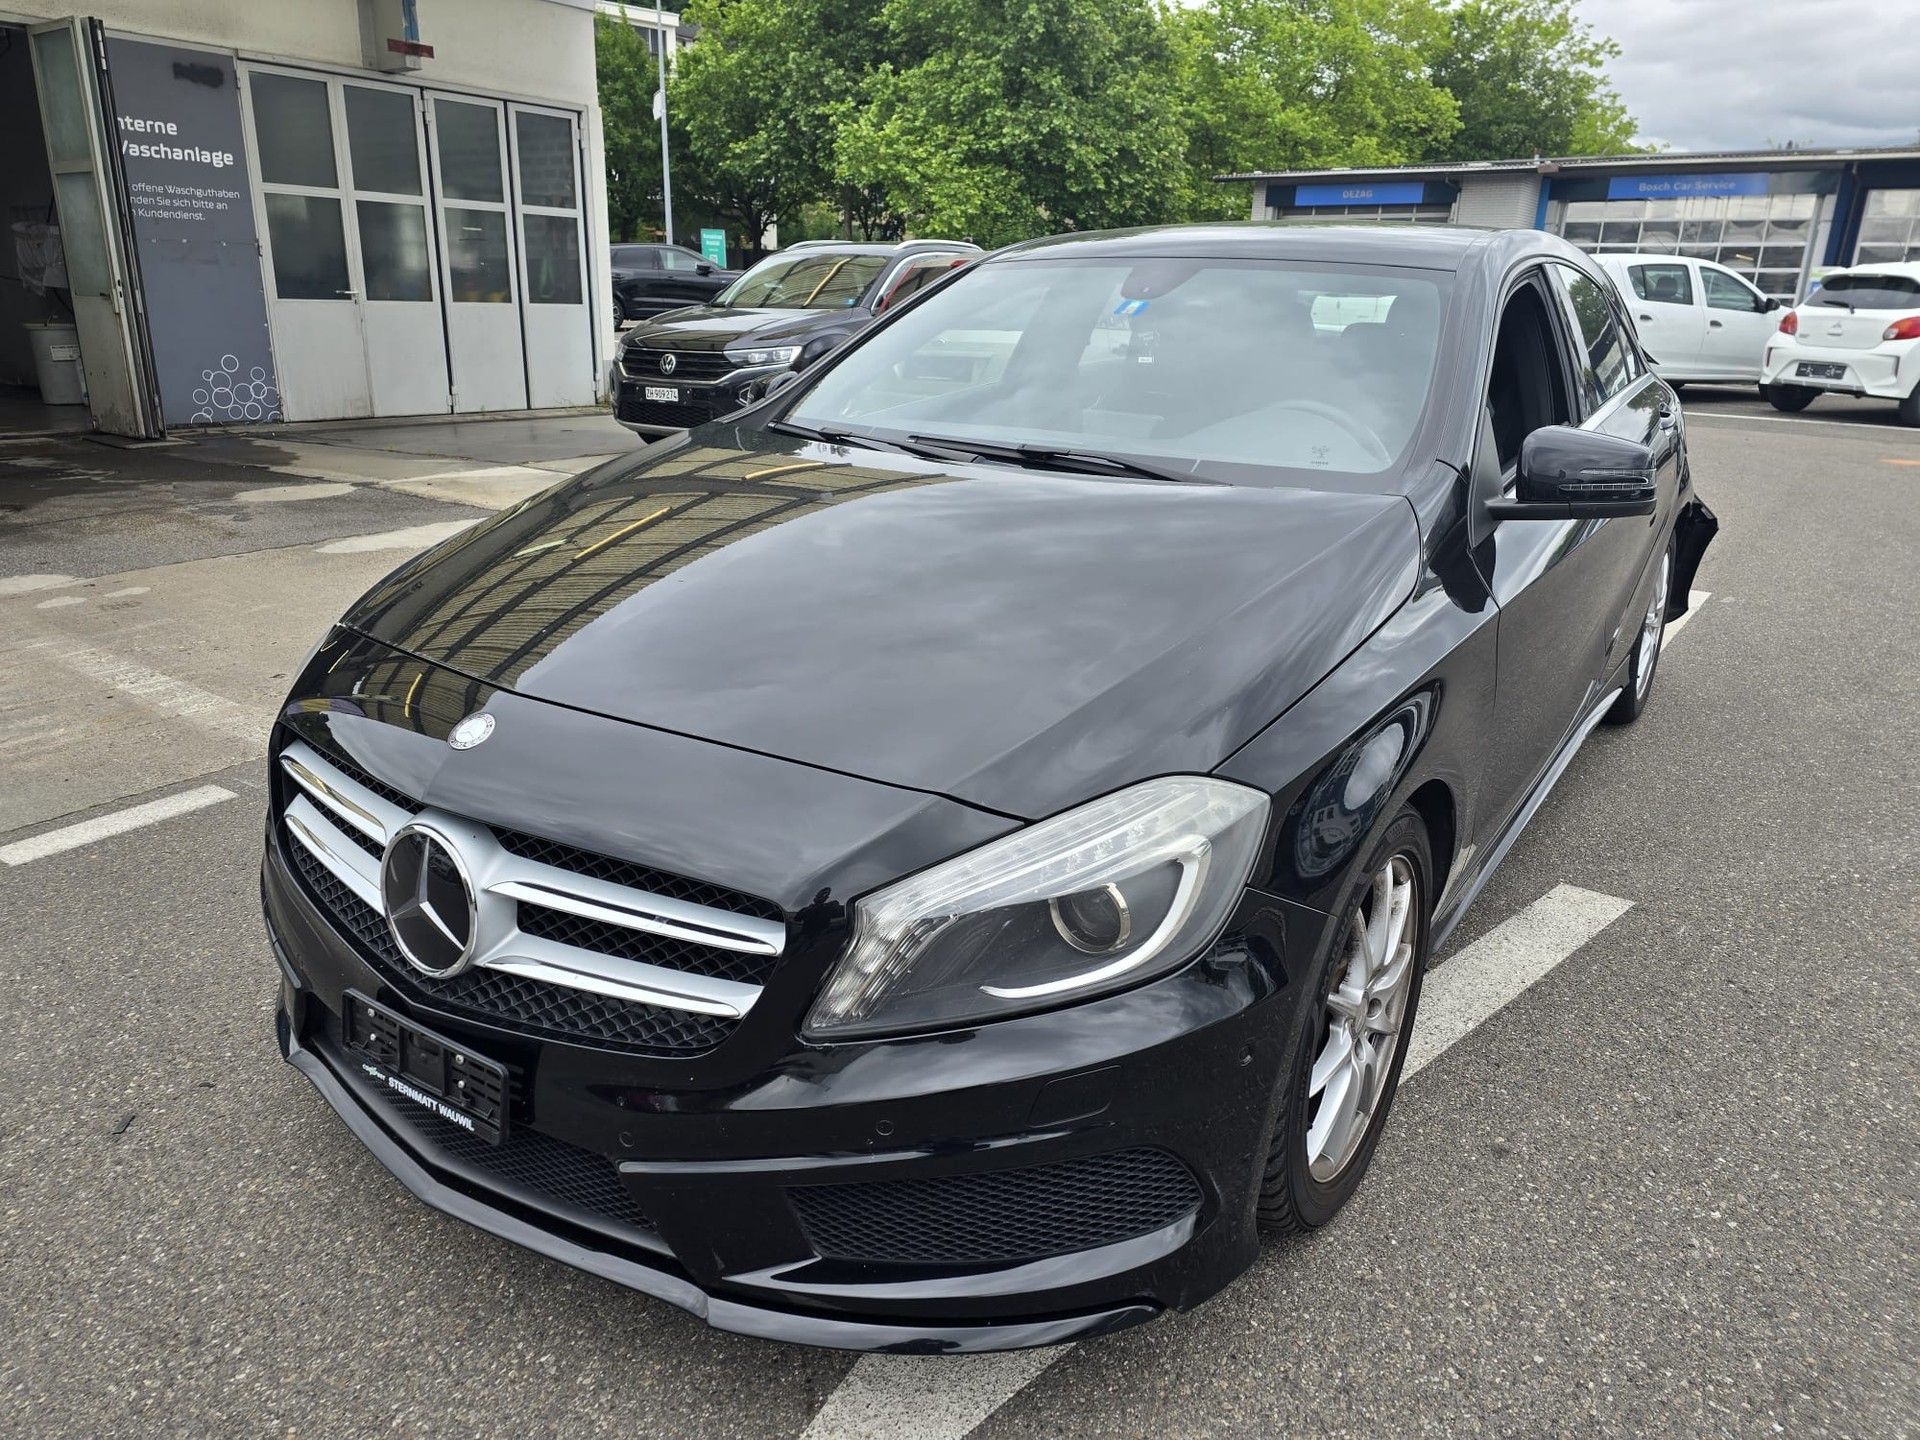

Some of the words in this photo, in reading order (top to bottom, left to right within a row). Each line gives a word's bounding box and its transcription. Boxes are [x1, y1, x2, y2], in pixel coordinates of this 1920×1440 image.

[117, 115, 178, 136] nterne
[131, 182, 164, 193] offene
[165, 184, 240, 199] Waschguthaben
[1638, 182, 1671, 192] Bosch
[1673, 181, 1692, 191] Car
[1695, 179, 1736, 191] Service
[130, 194, 156, 206] nden
[156, 196, 171, 206] Sie
[172, 197, 191, 208] sich
[192, 198, 215, 210] bitte
[216, 201, 228, 210] an
[138, 208, 206, 221] Kundendienst.
[388, 1076, 439, 1112] STERNMATT
[438, 1102, 475, 1132] WAUWIL
